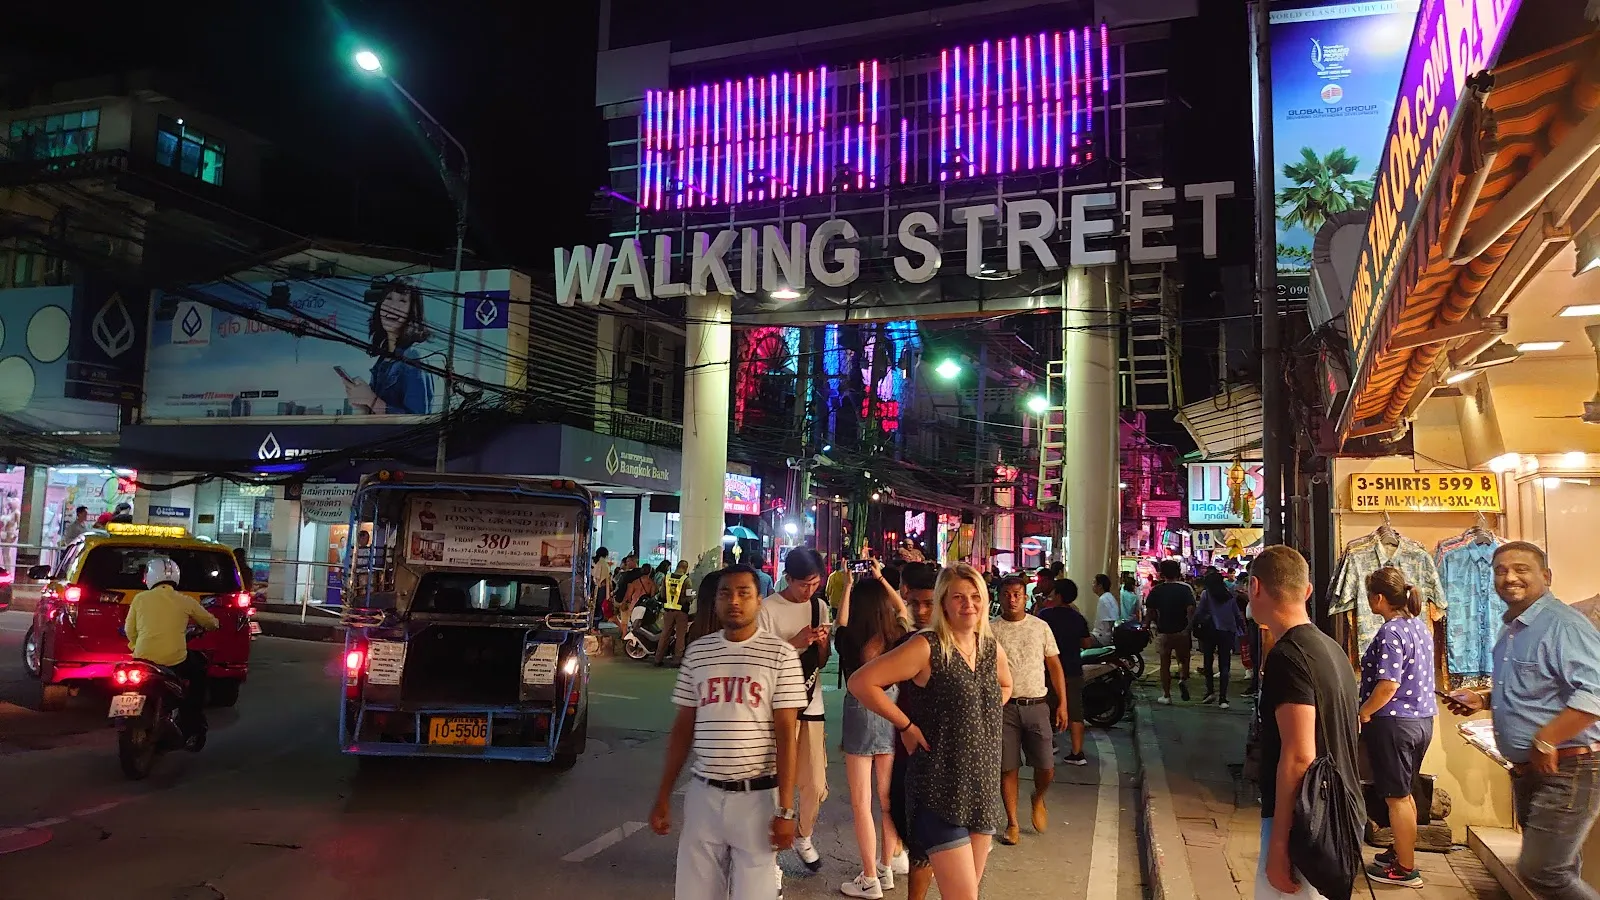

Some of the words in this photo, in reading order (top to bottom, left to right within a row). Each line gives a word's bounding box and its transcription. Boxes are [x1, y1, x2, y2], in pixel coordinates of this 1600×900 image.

[1305, 8, 1338, 17] CLASS
[1288, 108, 1323, 116] GLOBAL
[1325, 106, 1343, 114] TOP
[1345, 104, 1377, 112] GROUP
[554, 219, 861, 307] WALKING
[893, 180, 1235, 284] STREET
[1348, 250, 1372, 352] LOUIS
[620, 461, 651, 479] Bangkok
[652, 466, 670, 481] Bank
[1357, 477, 1431, 491] 3-SHIRTS
[1439, 477, 1474, 491] 599
[1357, 495, 1380, 507] SIZE
[1384, 495, 1496, 507] ML-XL-2XL-3XL-4XL
[477, 533, 511, 550] 380
[699, 675, 763, 709] LEVI'S
[435, 723, 488, 738] 10-5506
